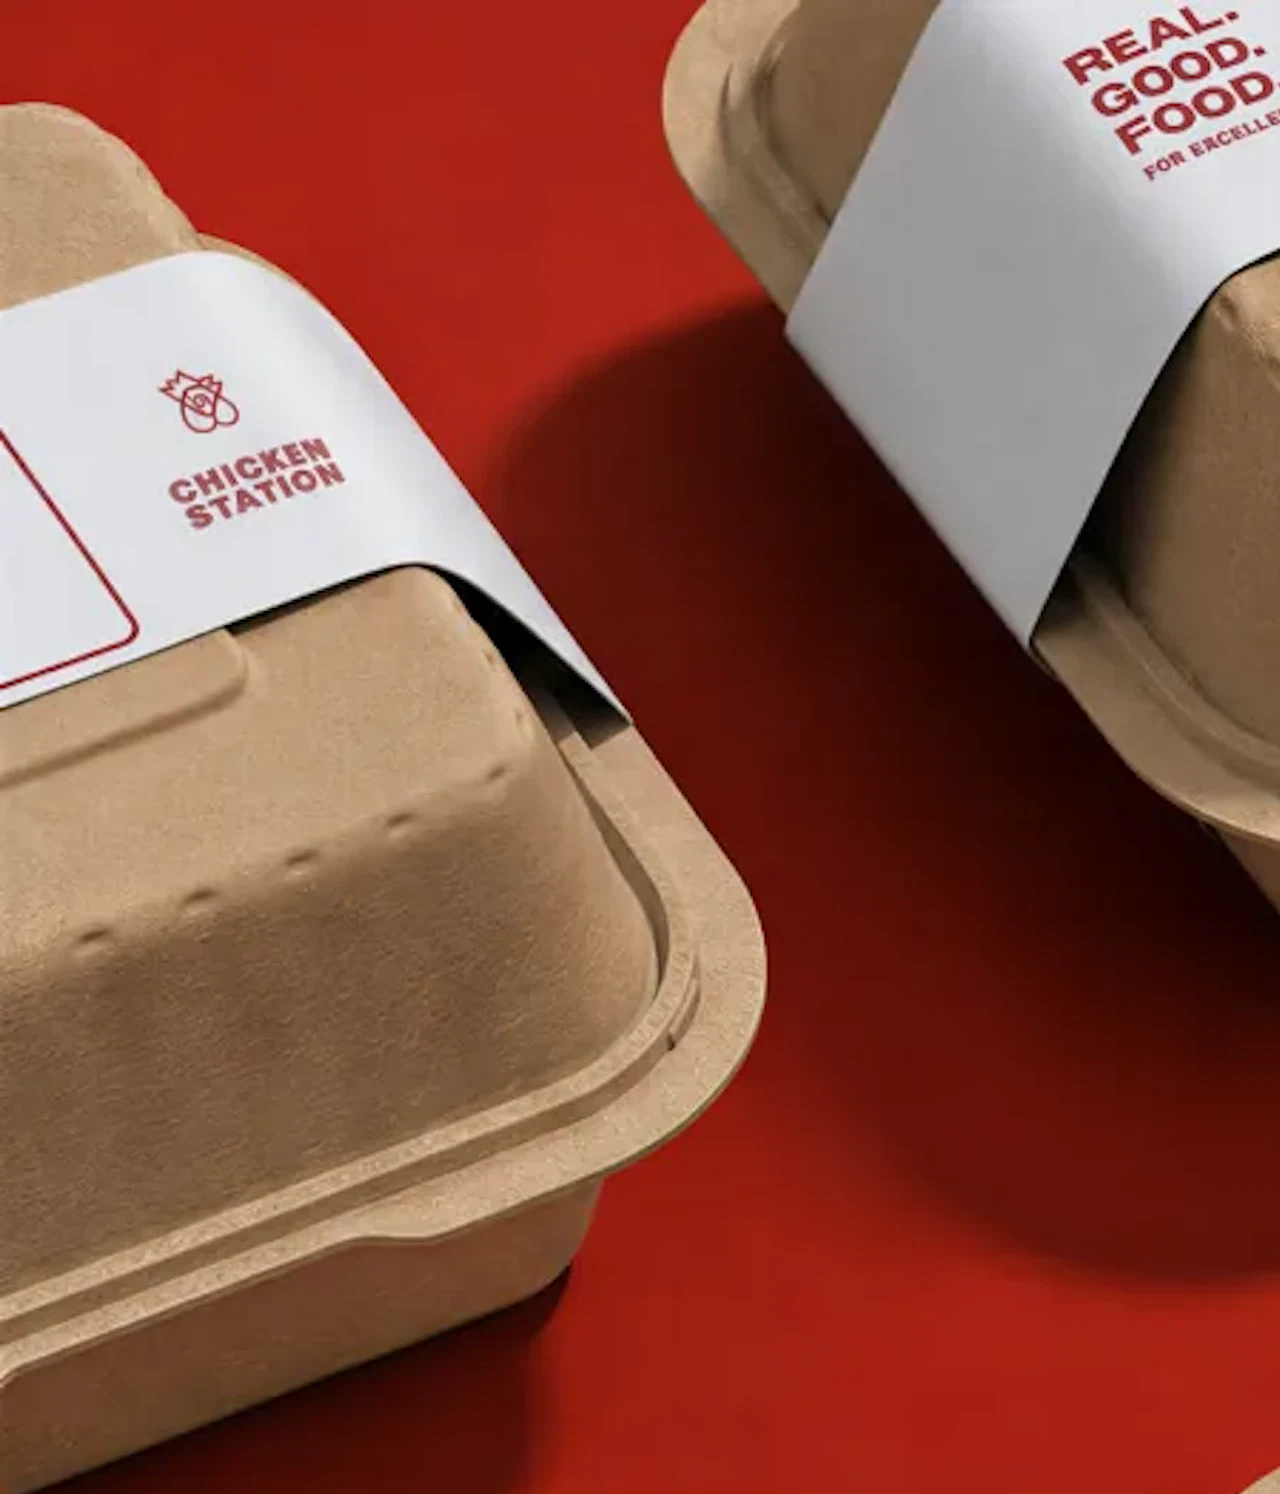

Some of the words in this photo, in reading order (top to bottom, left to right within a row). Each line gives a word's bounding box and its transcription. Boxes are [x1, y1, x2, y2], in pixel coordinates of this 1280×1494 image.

[1061, 5, 1240, 86] REAL.
[1092, 37, 1266, 117] GOOD.
[1143, 151, 1185, 181] FOR
[168, 438, 331, 503] CHICKEN
[185, 464, 346, 529] STATION
